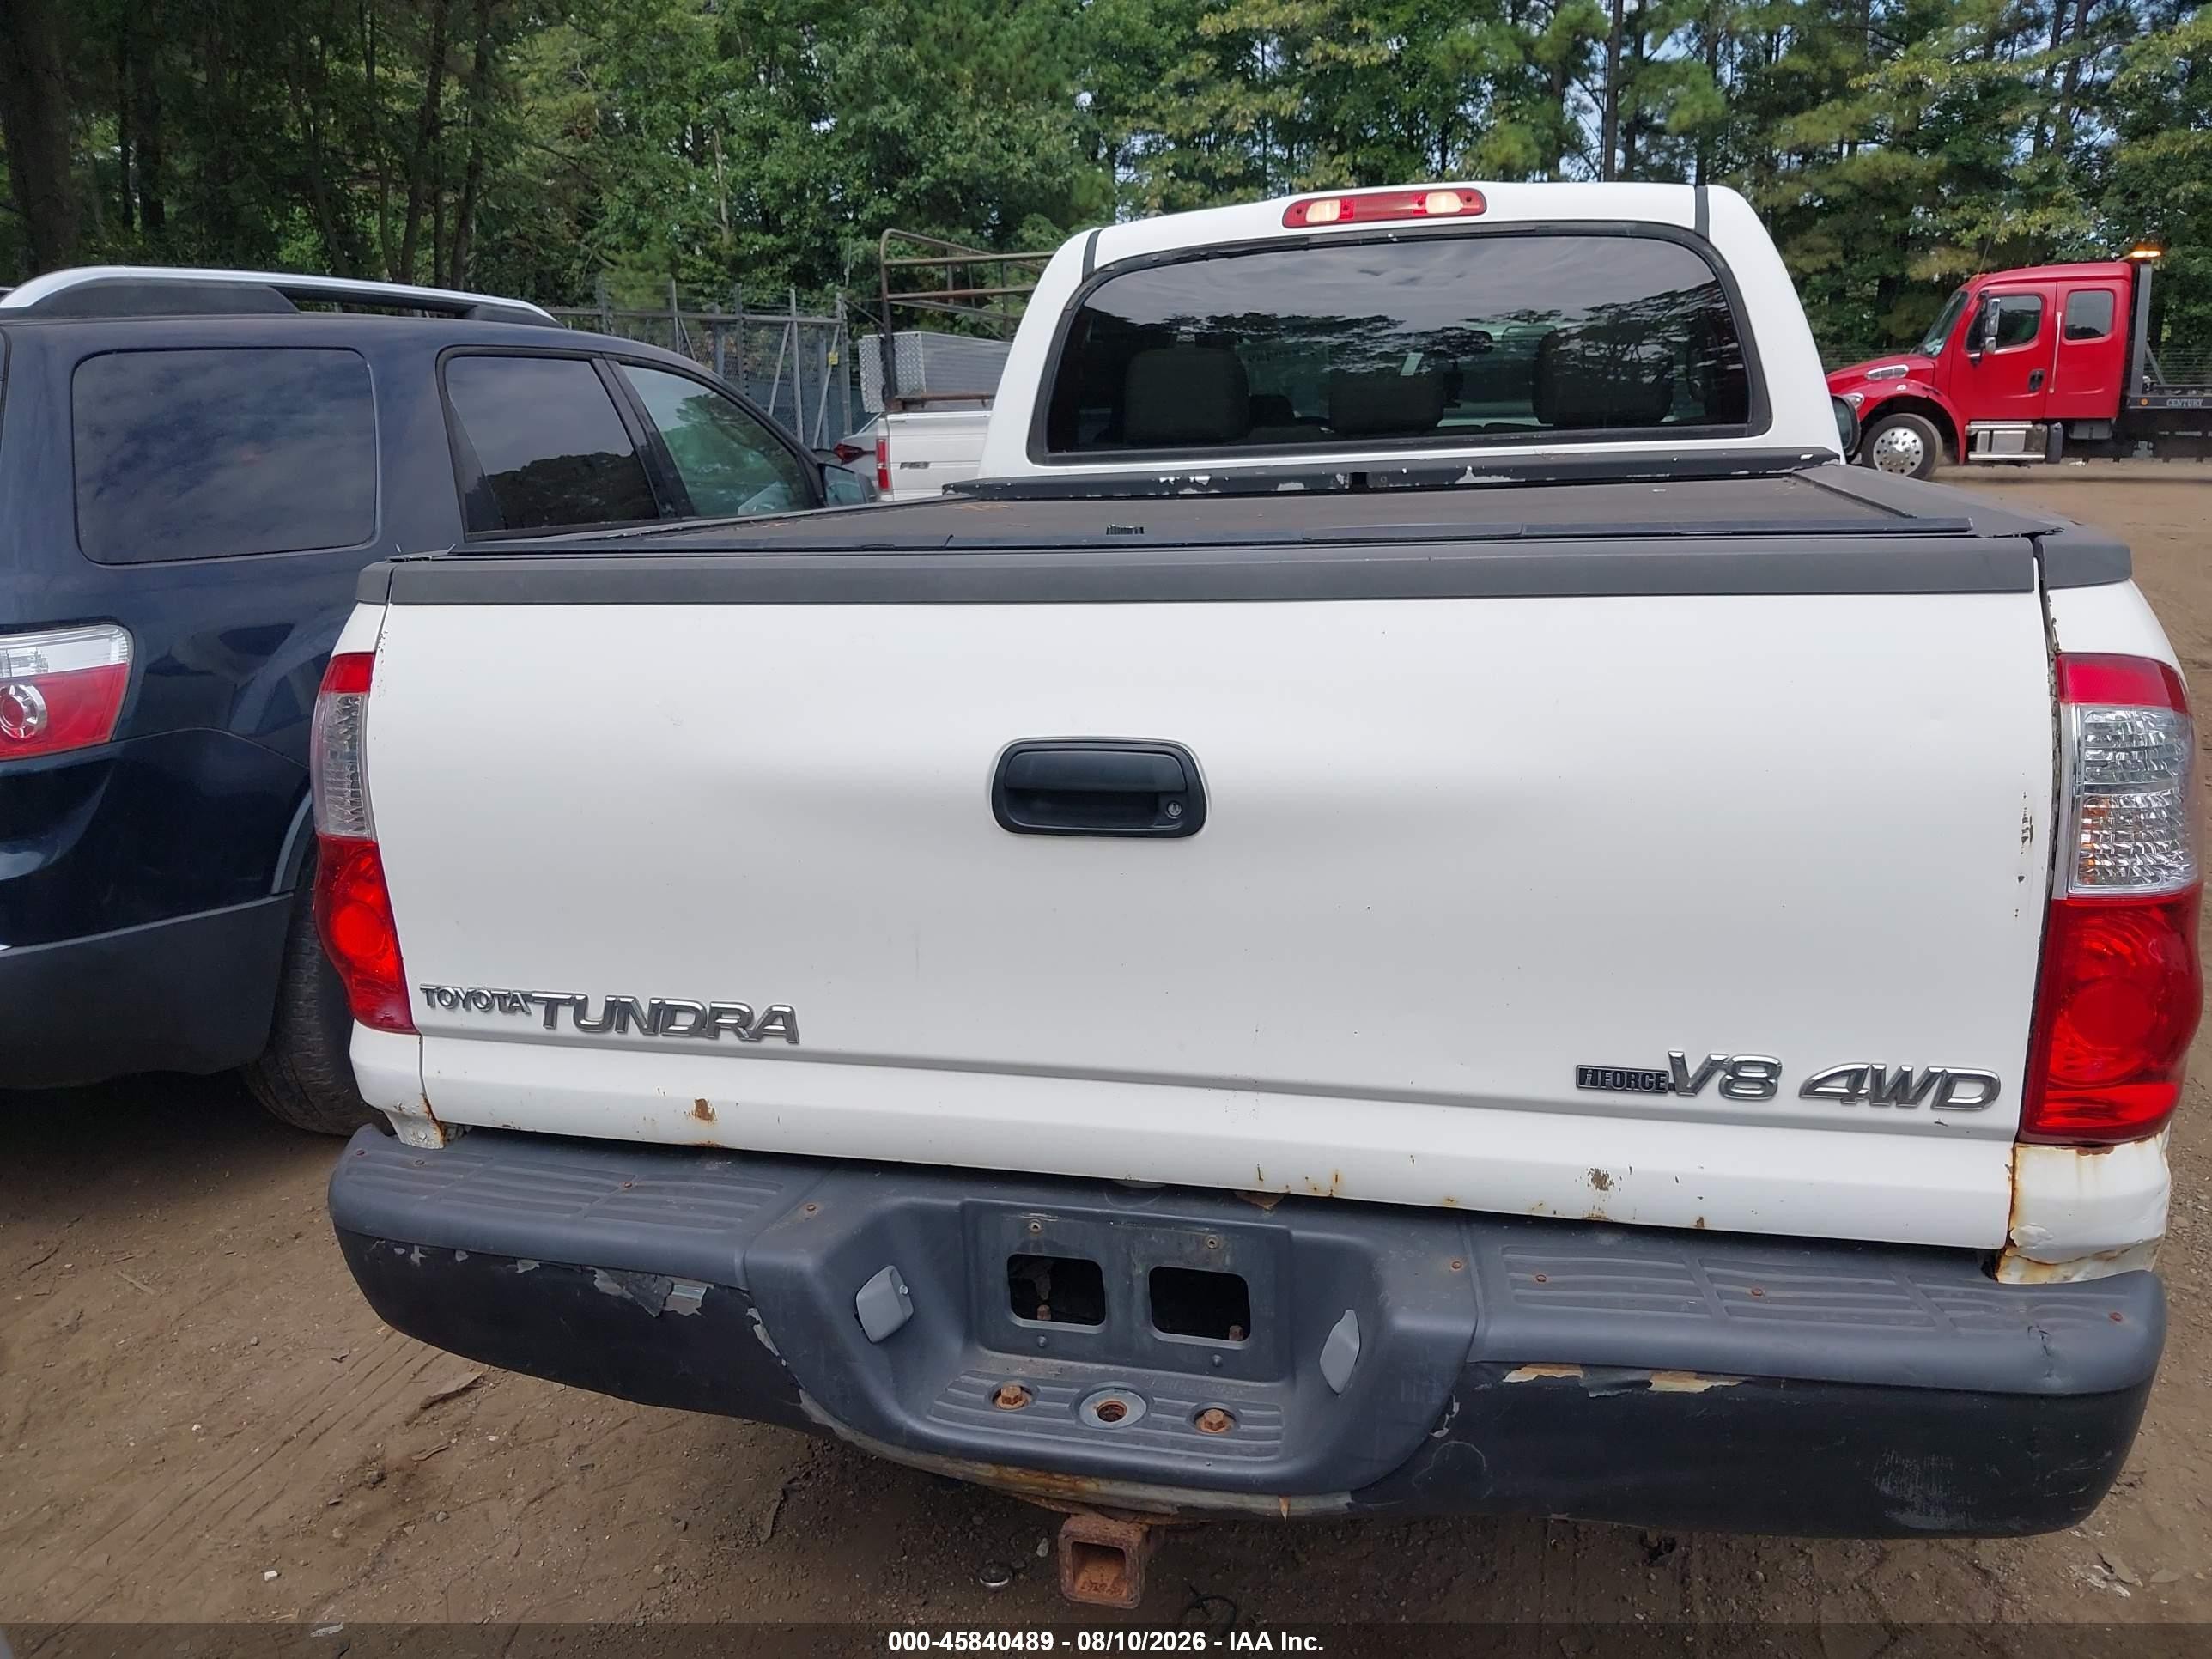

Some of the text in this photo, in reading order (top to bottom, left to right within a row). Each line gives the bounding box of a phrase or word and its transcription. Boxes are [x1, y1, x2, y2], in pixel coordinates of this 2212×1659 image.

[2166, 398, 2203, 407] CENTURY
[420, 984, 799, 1044] TOYOTA TUNDRA
[1668, 1050, 1783, 1101] V8
[1799, 1063, 2002, 1110] 4WD
